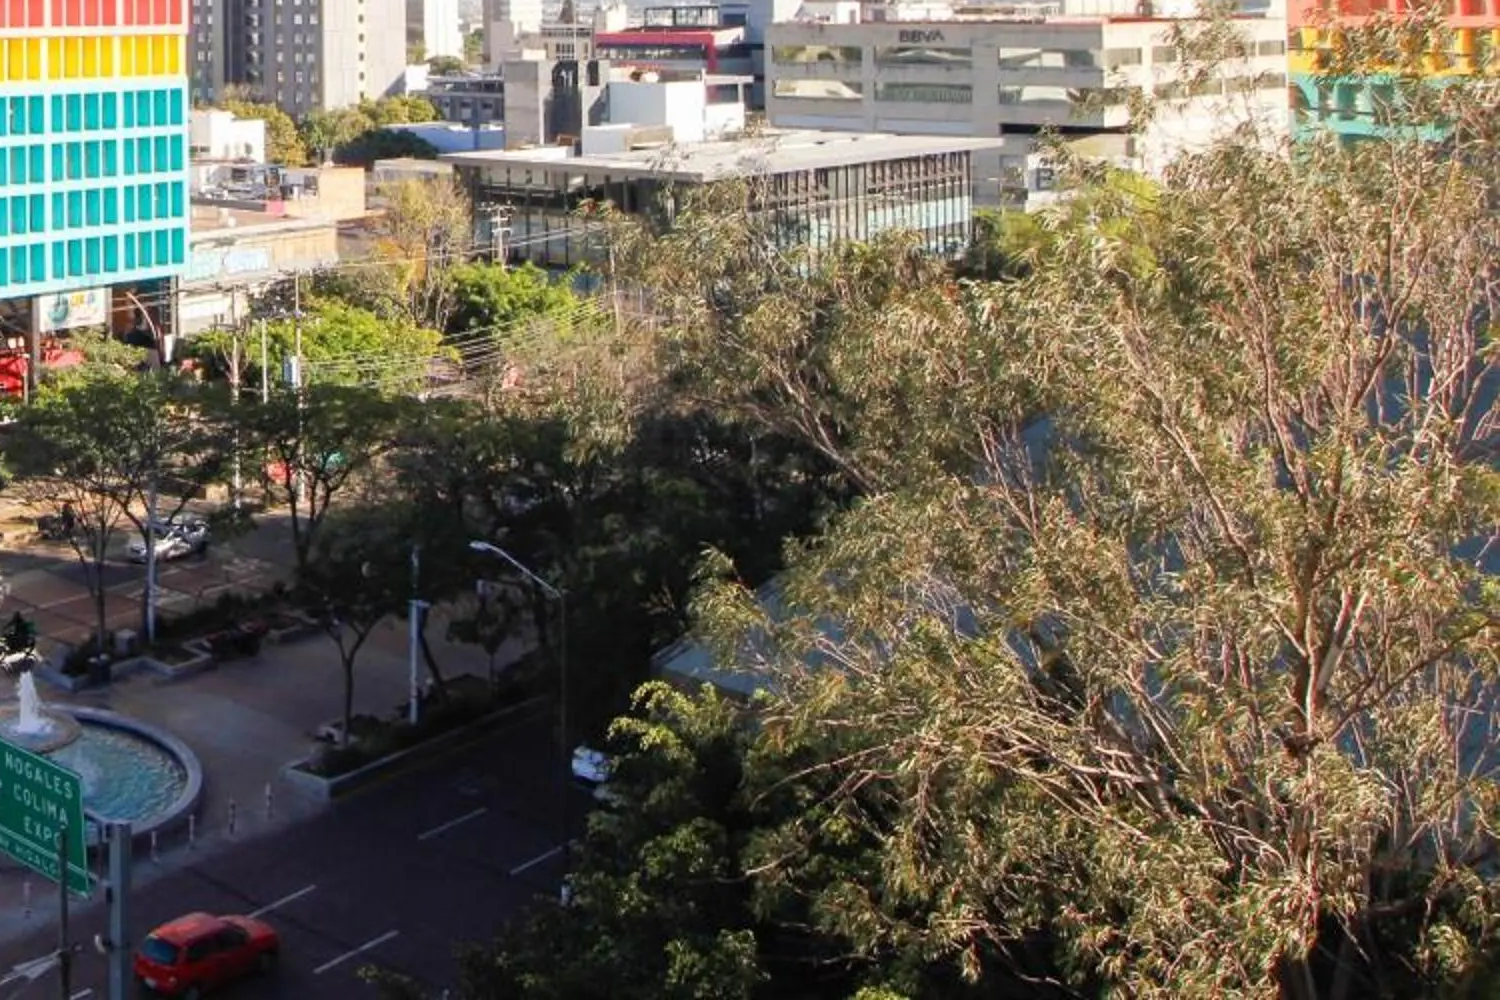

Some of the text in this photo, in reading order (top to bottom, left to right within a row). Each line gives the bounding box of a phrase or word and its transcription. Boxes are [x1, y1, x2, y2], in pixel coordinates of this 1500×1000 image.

[899, 29, 945, 43] BBVA
[5, 752, 73, 800] NOGALES
[13, 783, 68, 826] COLIMA
